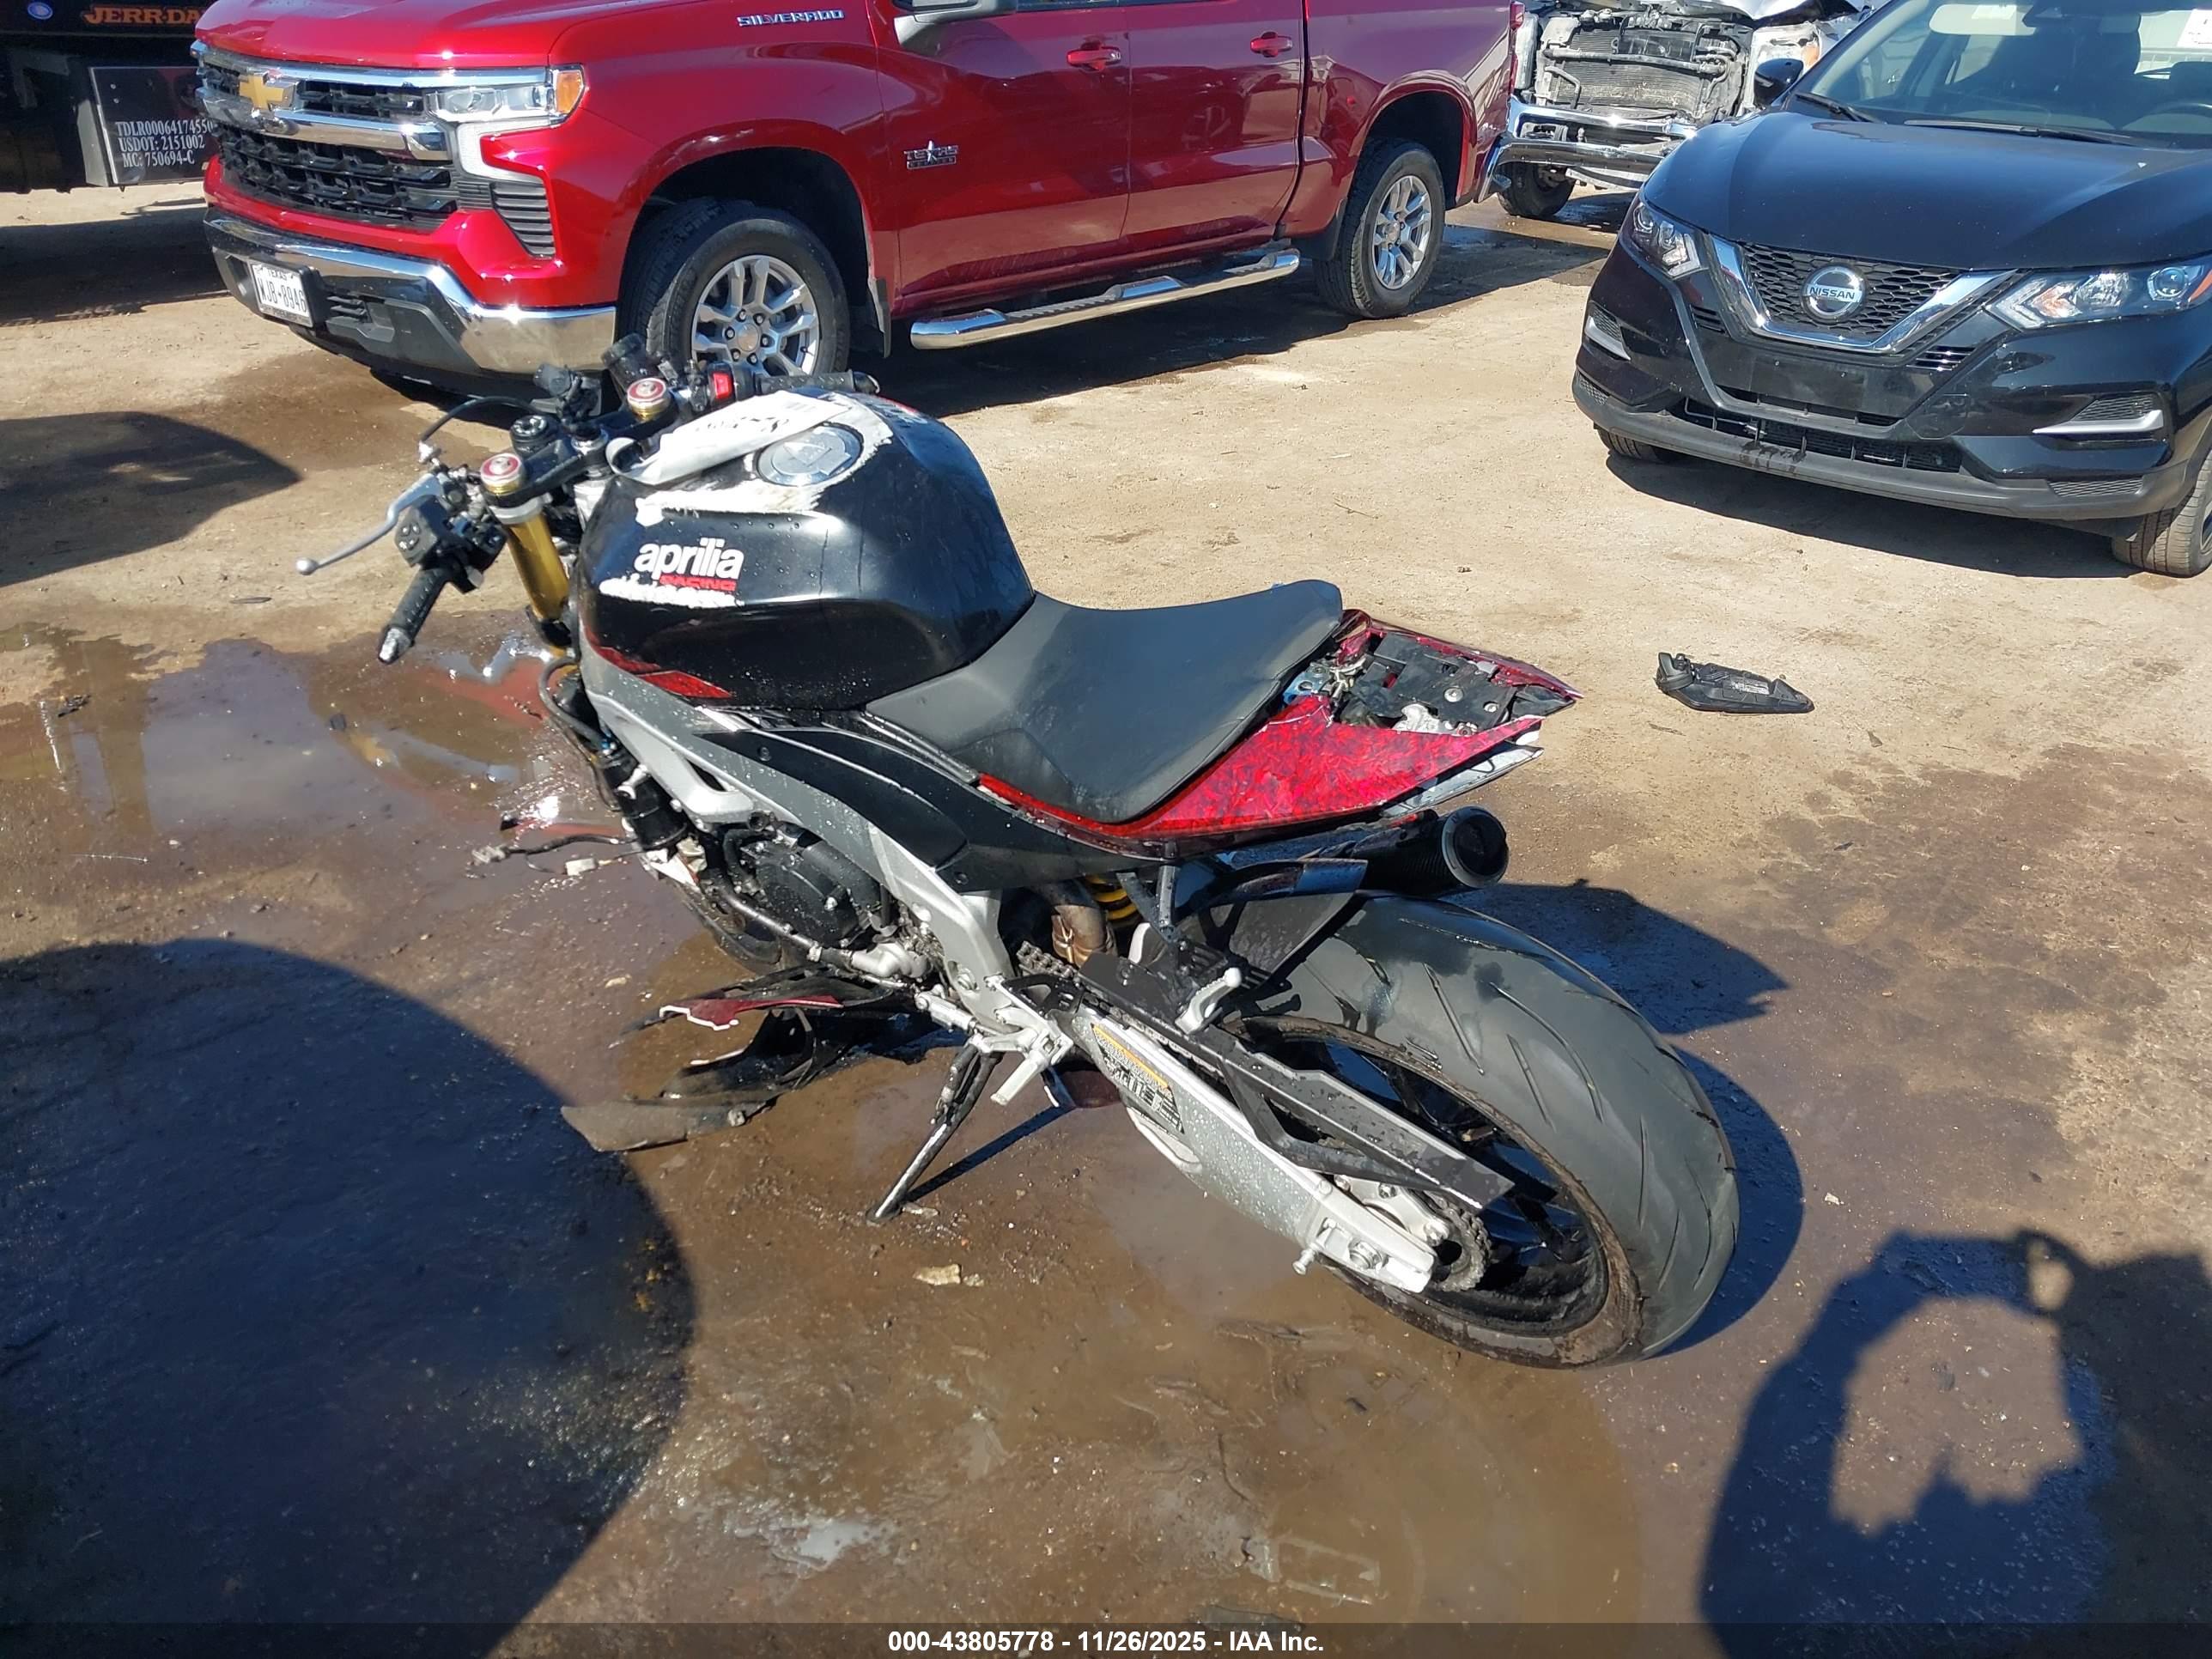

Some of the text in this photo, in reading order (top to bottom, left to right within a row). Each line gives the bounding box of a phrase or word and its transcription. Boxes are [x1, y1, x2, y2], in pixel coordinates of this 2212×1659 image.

[83, 6, 205, 24] JERR-DA
[737, 10, 844, 27] SILVERADO
[118, 135, 205, 152] USDOT: 2151002
[122, 149, 195, 167] MC: 750694-C
[1809, 287, 1855, 300] NISSAN
[634, 537, 744, 580] aprilia
[659, 574, 738, 592] RACING
